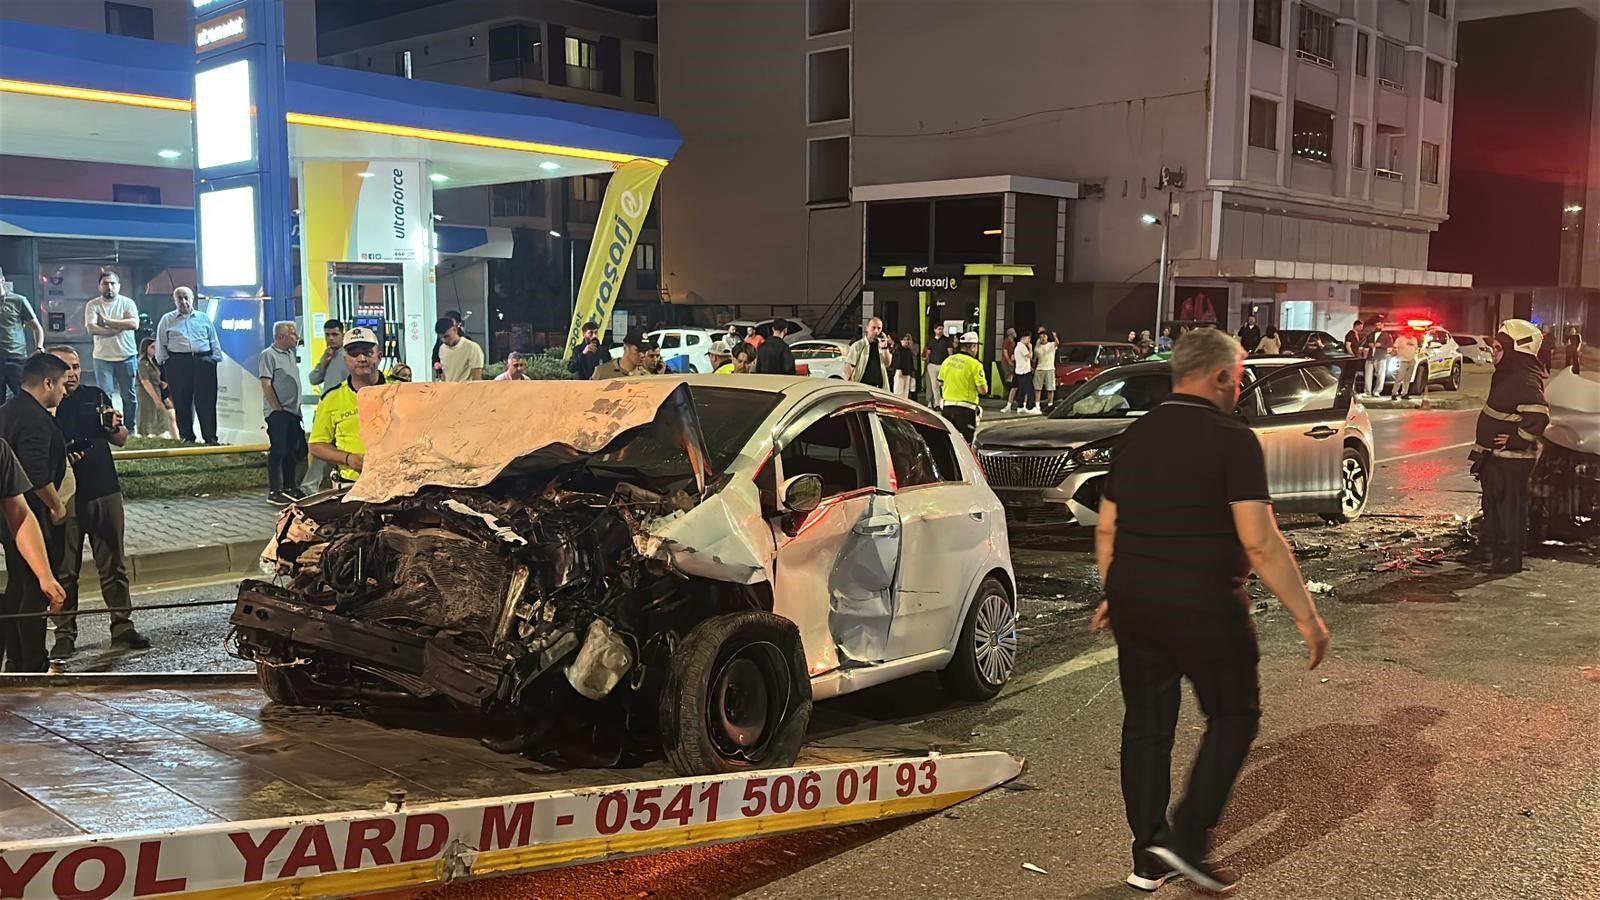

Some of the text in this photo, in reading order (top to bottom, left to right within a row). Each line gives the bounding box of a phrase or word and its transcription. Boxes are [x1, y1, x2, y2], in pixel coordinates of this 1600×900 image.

[392, 168, 405, 239] ultraforce
[589, 214, 633, 328] traşarj
[910, 277, 948, 289] ultraşarj
[0, 842, 186, 900] YOL
[230, 813, 449, 882] YARD
[478, 803, 535, 853] M
[594, 783, 721, 835] 0541
[741, 772, 822, 817] 506
[836, 767, 879, 805] 01
[896, 759, 938, 797] 93
